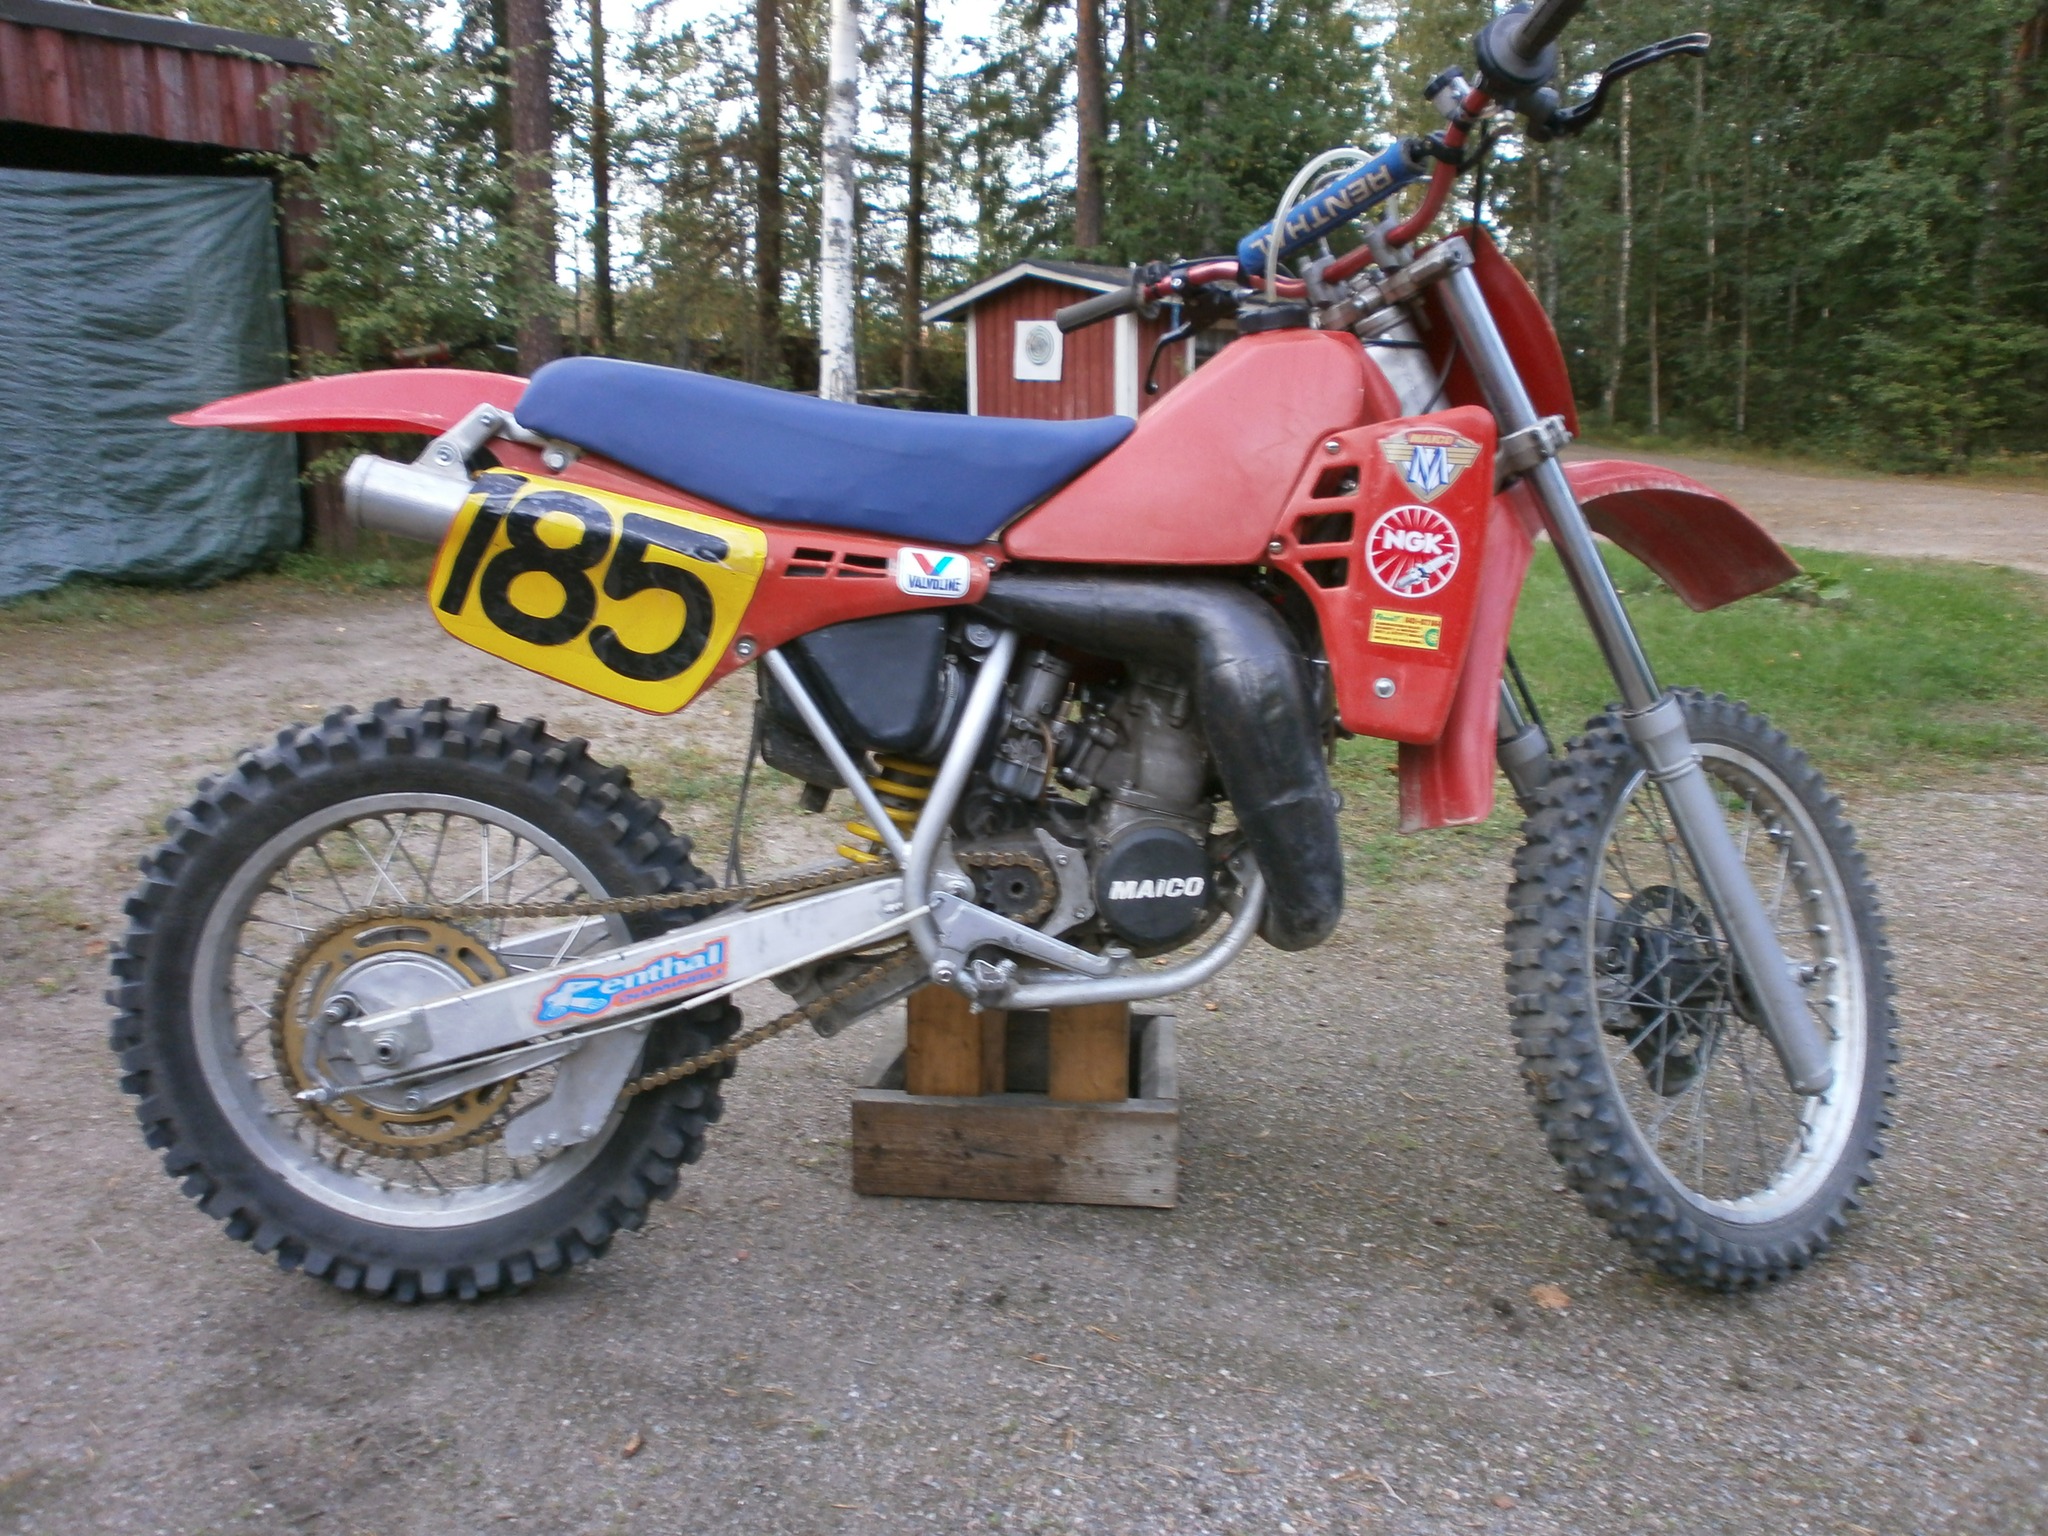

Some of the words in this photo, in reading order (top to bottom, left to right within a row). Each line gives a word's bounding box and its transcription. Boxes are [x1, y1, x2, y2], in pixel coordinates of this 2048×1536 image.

[1382, 529, 1445, 555] NGK
[438, 473, 728, 682] 185
[908, 574, 962, 591] VALVOLINE
[1108, 876, 1205, 900] MAICO
[543, 942, 723, 1019] Renthal
